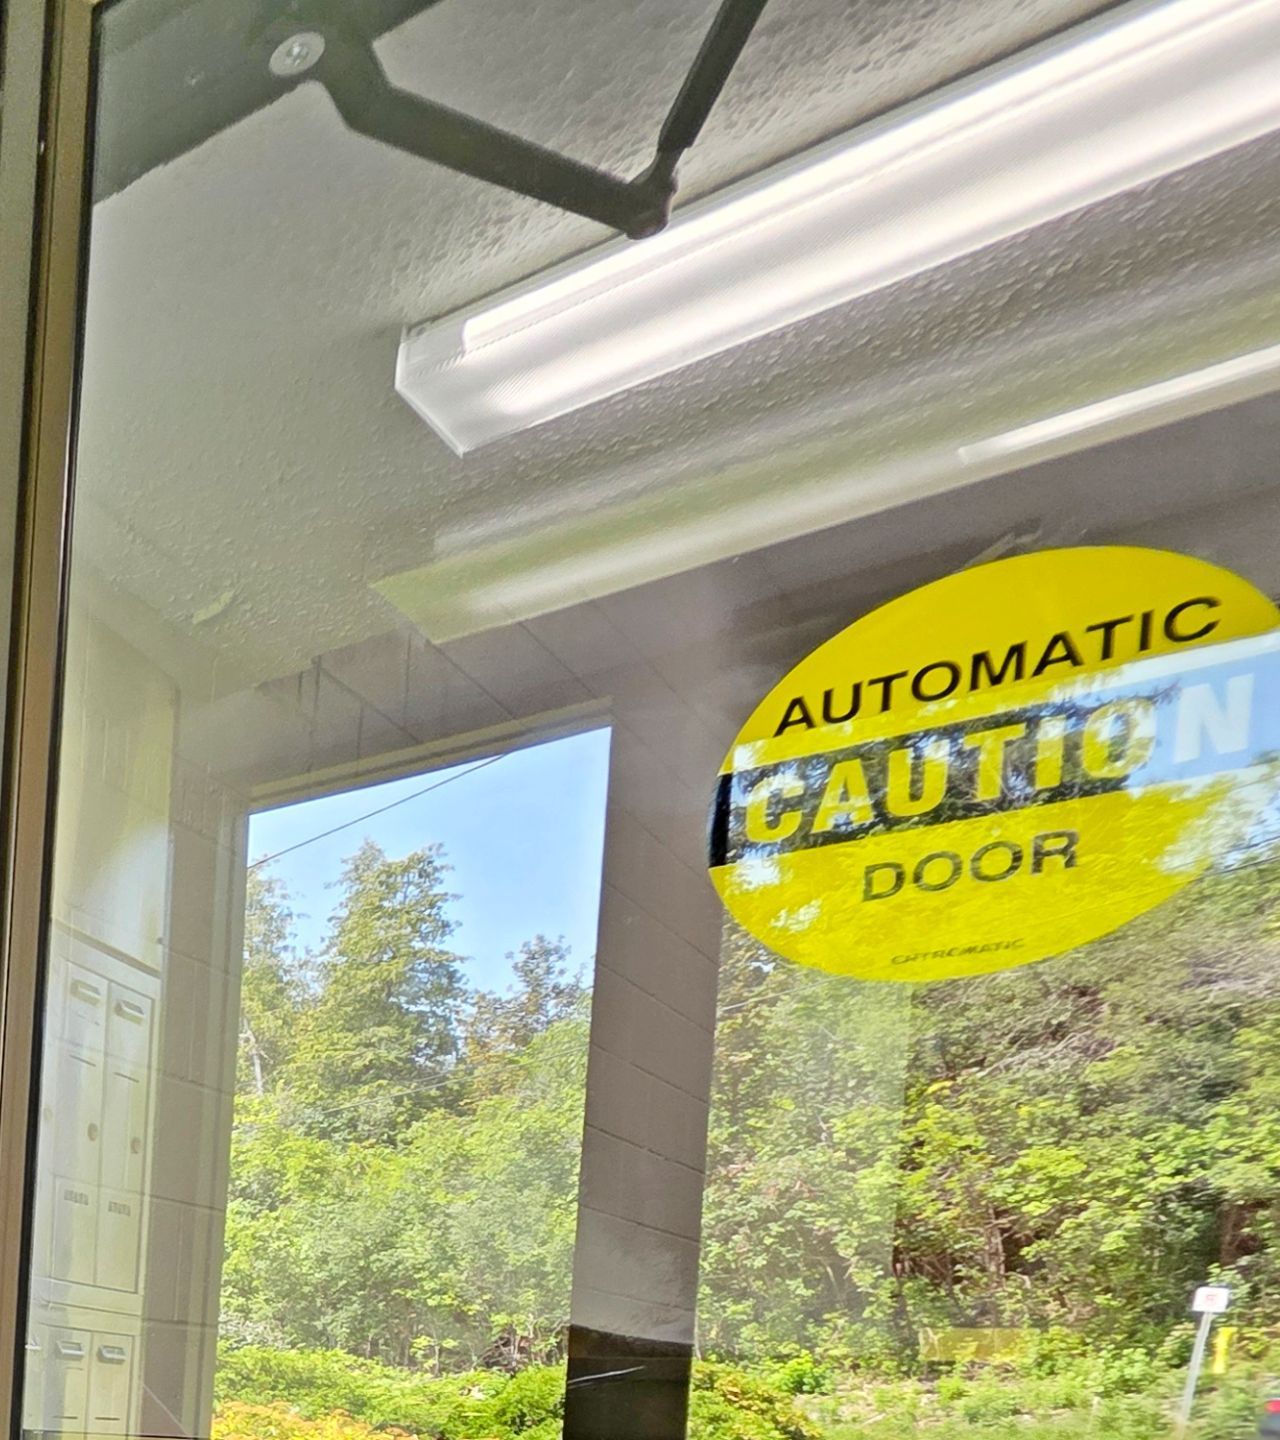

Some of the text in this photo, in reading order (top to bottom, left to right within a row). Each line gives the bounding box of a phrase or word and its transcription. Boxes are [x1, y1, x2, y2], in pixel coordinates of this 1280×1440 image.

[773, 596, 1224, 739] AUTOMATIC
[744, 673, 1255, 844] CAUTION
[861, 829, 1081, 903] DOOR
